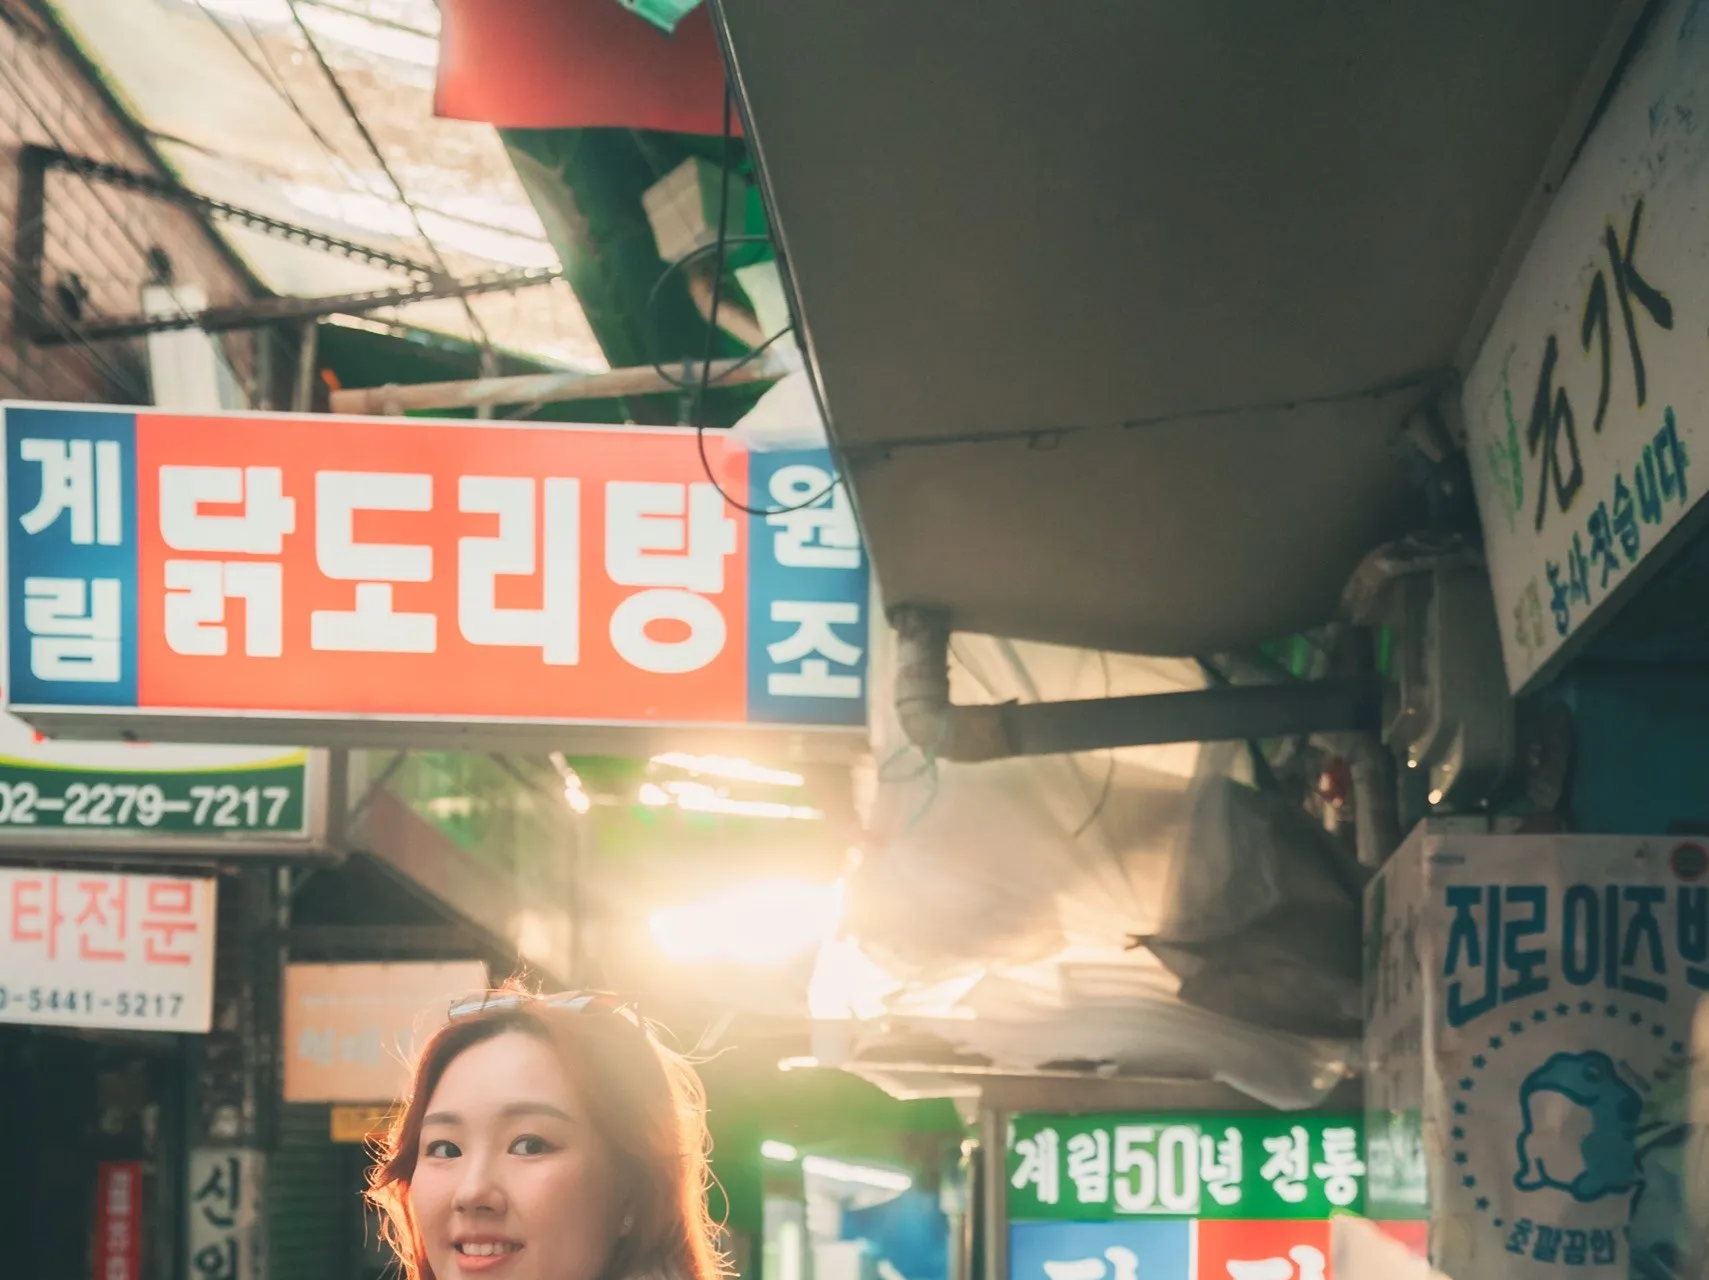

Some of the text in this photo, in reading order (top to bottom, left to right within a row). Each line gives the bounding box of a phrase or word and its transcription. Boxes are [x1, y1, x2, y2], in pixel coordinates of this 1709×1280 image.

[20, 438, 122, 683] 계림
[158, 464, 738, 674] 닭도리탕
[765, 464, 864, 699] 원조
[11, 875, 200, 966] 타전문
[1260, 1126, 1367, 1206] 전통
